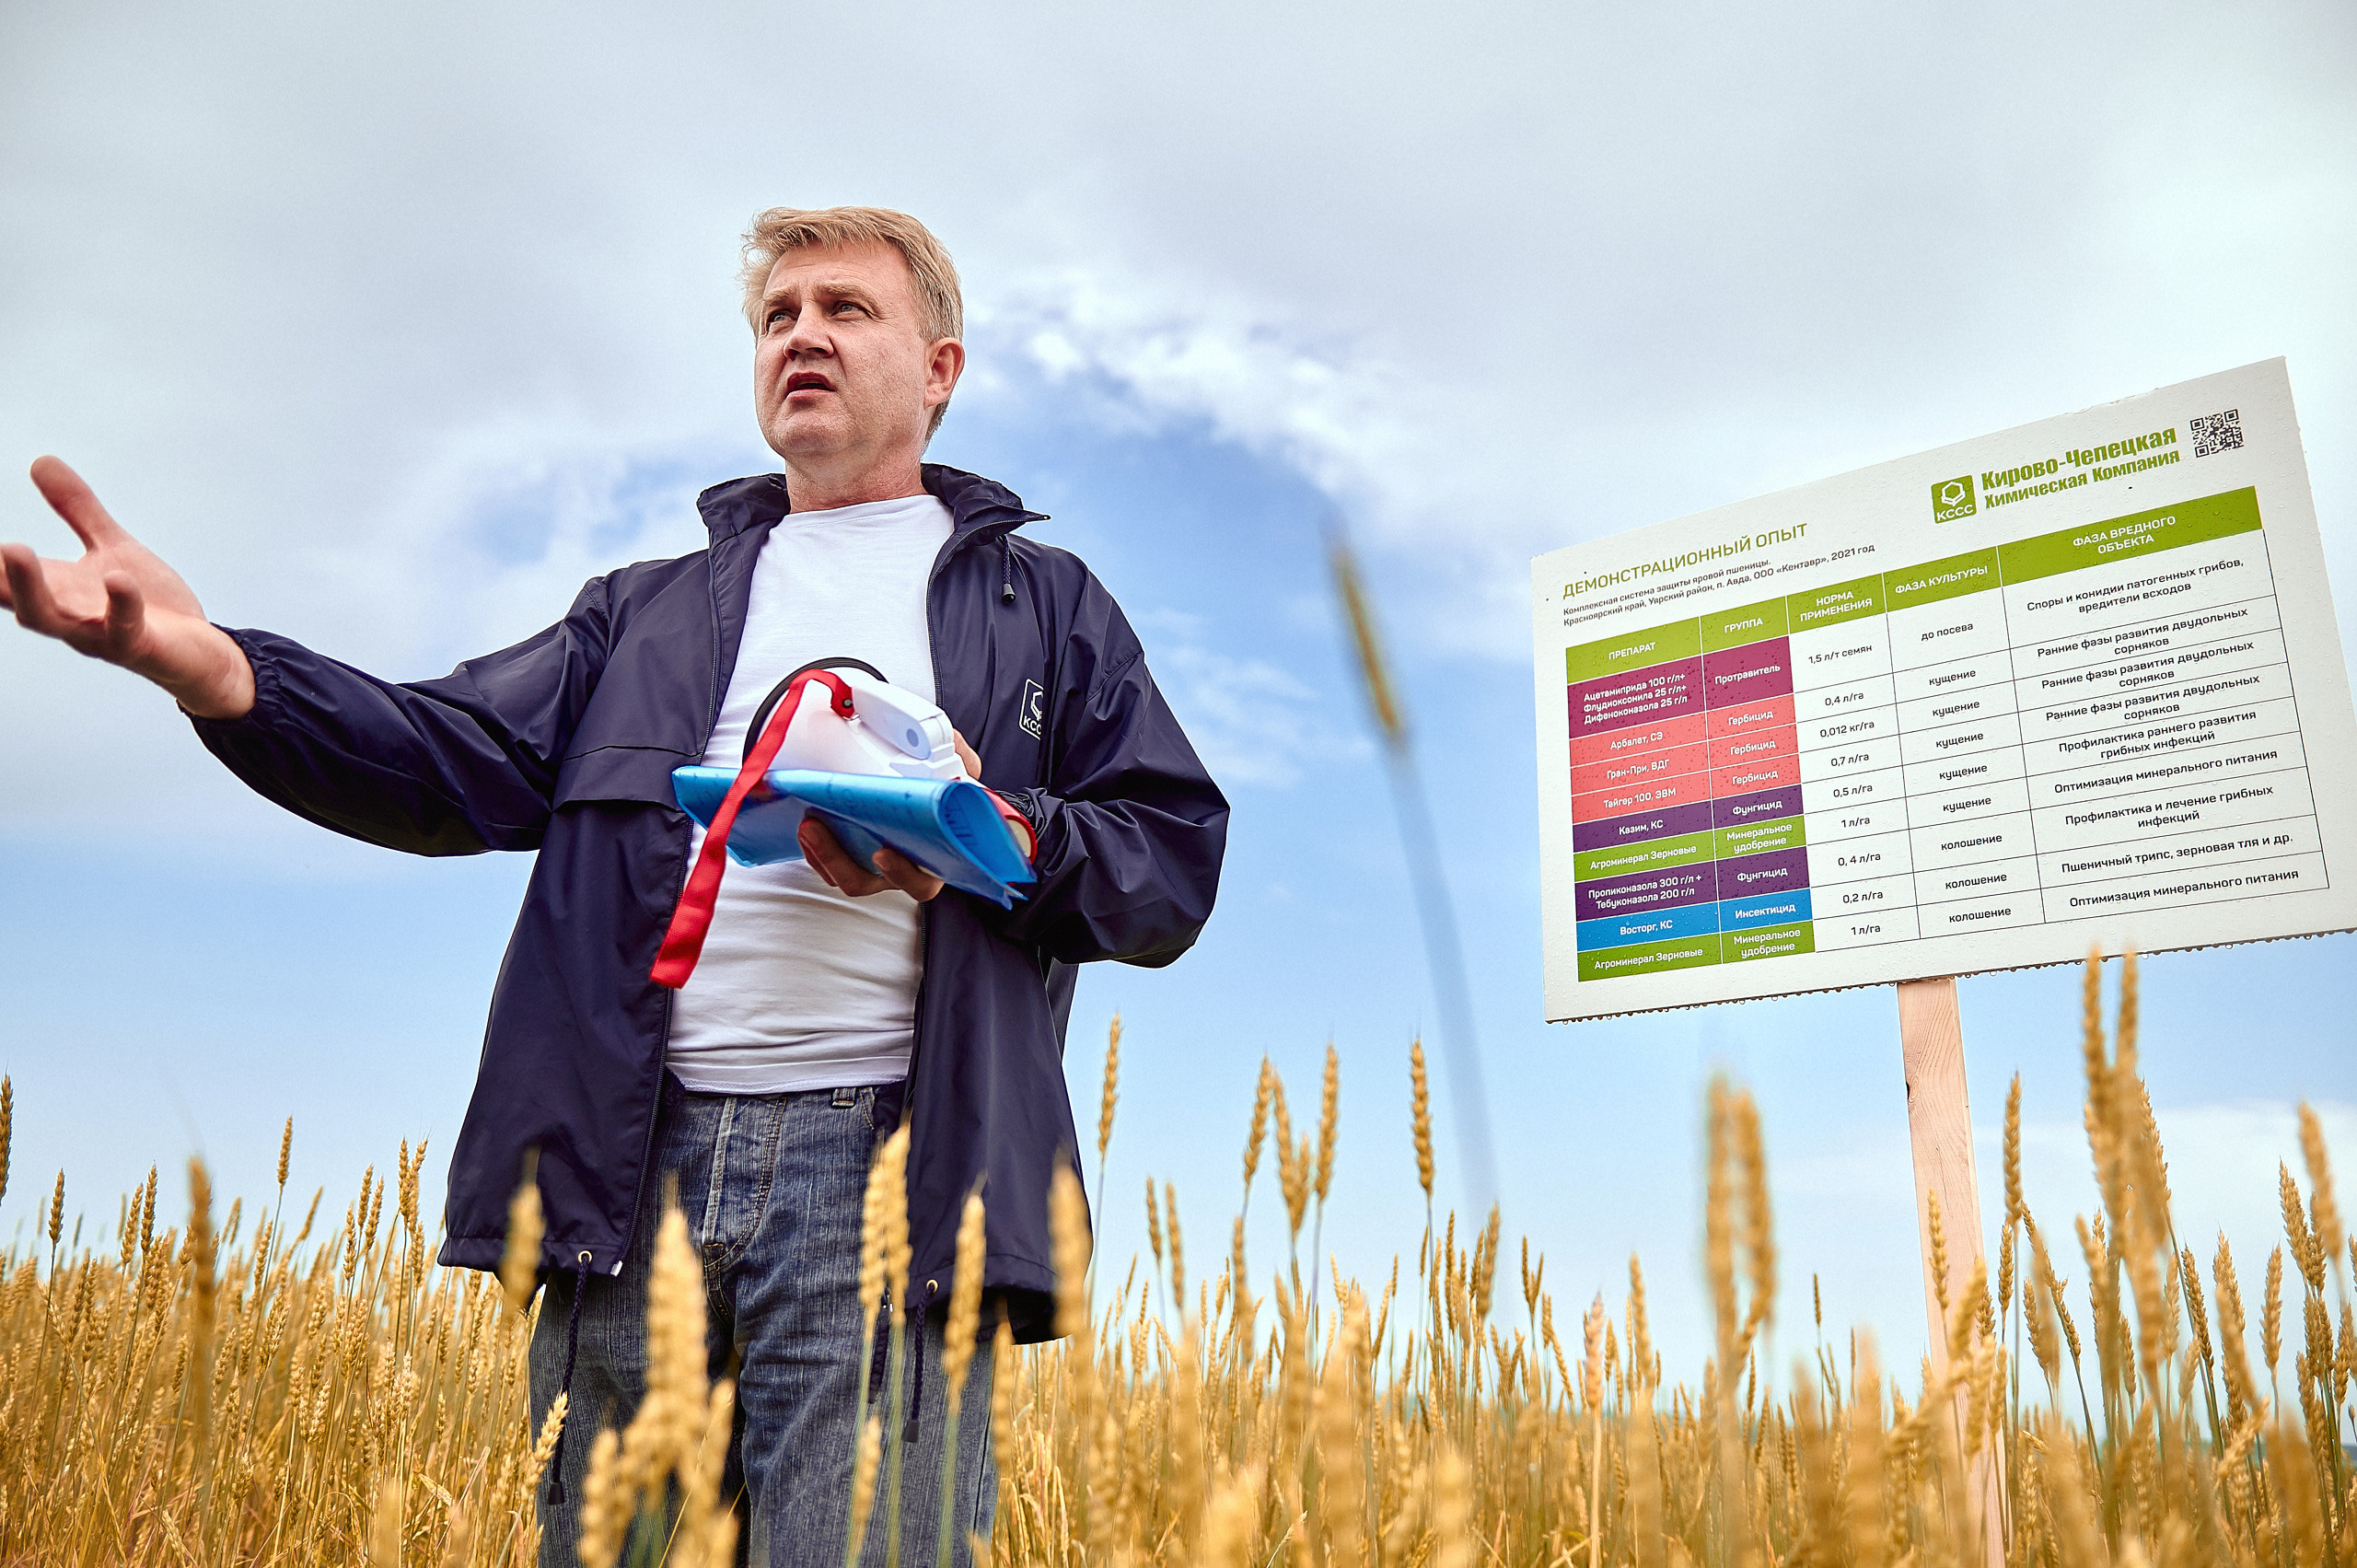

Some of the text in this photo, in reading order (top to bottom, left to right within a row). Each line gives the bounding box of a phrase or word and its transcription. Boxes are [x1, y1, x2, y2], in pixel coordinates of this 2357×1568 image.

[1980, 427, 2177, 490] Кирово-Чепецкая
[1984, 449, 2179, 508] Химическая Компания
[2073, 516, 2176, 546] ФАЗА ВРЕДНОГО
[2097, 533, 2154, 553] ОБЪЕКТА
[1562, 522, 1806, 599] ДЕМОНСТРАЦИОННЫЙ ОПЫТ
[1562, 559, 1771, 615] Комплексная система защиты яровой пшеницы.
[1563, 605, 1622, 626] Красноярский
[1624, 599, 1646, 611] край,
[1648, 589, 1684, 605] Уярский
[1686, 584, 1714, 598] район,
[1726, 575, 1751, 586] Авда,
[1753, 567, 1773, 579] ООО
[1776, 557, 1829, 573] «Кентавр»,
[1830, 547, 1855, 561] 2021
[1857, 544, 1875, 554] год
[1895, 564, 1988, 593] ФАЗА КУЛЬТУРЫ
[2026, 597, 2063, 610] Споры
[2075, 584, 2124, 600] конидии
[2126, 568, 2196, 589] патогенных
[2198, 559, 2243, 575] грибов,
[1816, 590, 1853, 606] НОРМА
[2078, 583, 2191, 613] вредители всходов
[1799, 597, 1872, 621] ПРИМЕНЕНИЯ
[1724, 617, 1763, 633] ГРУППА
[1921, 623, 1973, 641] до посева
[2037, 609, 2247, 656] Ранние фазы развития двудольных
[1608, 641, 1655, 659] ПРЕПАРАТ
[1808, 645, 1872, 664] 1,5 л/т семян
[2114, 637, 2169, 655] сорняков
[2041, 642, 2254, 689] Ранние фазы развития двудольных
[1714, 665, 1781, 685] Протравитель
[1929, 669, 1976, 686] кущение
[2119, 670, 2174, 687] сорняков
[1584, 673, 1685, 702] Ацетамиприда 100 г/л+
[1583, 684, 1686, 712] Флудиоксонила 25 г/л+
[1824, 692, 1864, 705] 0,4 л/га
[2046, 675, 2259, 721] Ранние фазы развития двудольных
[1584, 694, 1687, 725] Дифеноконазола 25 г/л
[1932, 701, 1980, 717] кущение
[2123, 703, 2179, 720] сорняков
[1728, 711, 1773, 726] Гербицид
[1819, 721, 1875, 738] 0,012 кг/га
[2058, 711, 2256, 752] Профилактика раннего развития
[1609, 731, 1663, 750] Арбалет, СЭ
[1730, 740, 1776, 755] Гербицид
[1935, 733, 1983, 749] кущение
[2100, 730, 2214, 760] грибных инфекций
[1830, 753, 1869, 766] 0,7 л/га
[1607, 758, 1669, 780] Гран-При, ВДГ
[1732, 770, 1778, 785] Гербицид
[1939, 764, 1987, 780] кущение
[2054, 750, 2277, 793] Оптимизация минерального питания
[1603, 786, 1676, 807] Тайгер 100, ЭВМ
[1832, 784, 1873, 797] 0,5 л/га
[1732, 800, 1782, 816] Фунгицид
[1943, 797, 1991, 812] кущение
[2064, 805, 2152, 826] Профилактика
[2165, 795, 2216, 809] лечение
[2219, 786, 2273, 803] грибных
[1619, 819, 1663, 835] Казим, КС
[1840, 817, 1870, 828] 1 л/га
[2137, 809, 2200, 828] инфекций
[1726, 823, 1792, 841] Минеральное
[1733, 837, 1786, 854] удобрение
[1941, 834, 2002, 850] колошение
[1589, 845, 1697, 869] Агроминерал Зерновые
[1859, 853, 1880, 863] л/га
[2061, 854, 2132, 873] Пшеничный
[2134, 851, 2173, 864] трипс,
[2176, 842, 2235, 857] зерновая
[2236, 838, 2258, 848] тля
[2273, 834, 2293, 845] др.
[1736, 867, 1788, 882] Фунгицид
[1945, 874, 2007, 889] колошение
[1588, 881, 1657, 900] Пропиконазола
[1658, 876, 1678, 888] 300
[1679, 875, 1693, 884] г/л
[1842, 890, 1883, 903] 0,2 л/га
[2069, 870, 2298, 907] Оптимизация минерального питания
[1596, 887, 1694, 909] Тебуконазола 200 г/л
[1735, 903, 1795, 919] Инсектицид
[1948, 908, 2011, 923] колошение
[1620, 919, 1673, 935] Восторг, КС
[1851, 924, 1880, 935] 1 л/га
[1733, 929, 1800, 944] Минеральное
[1594, 948, 1703, 970] Агроминерал Зерновые
[1740, 943, 1794, 958] удобрение
